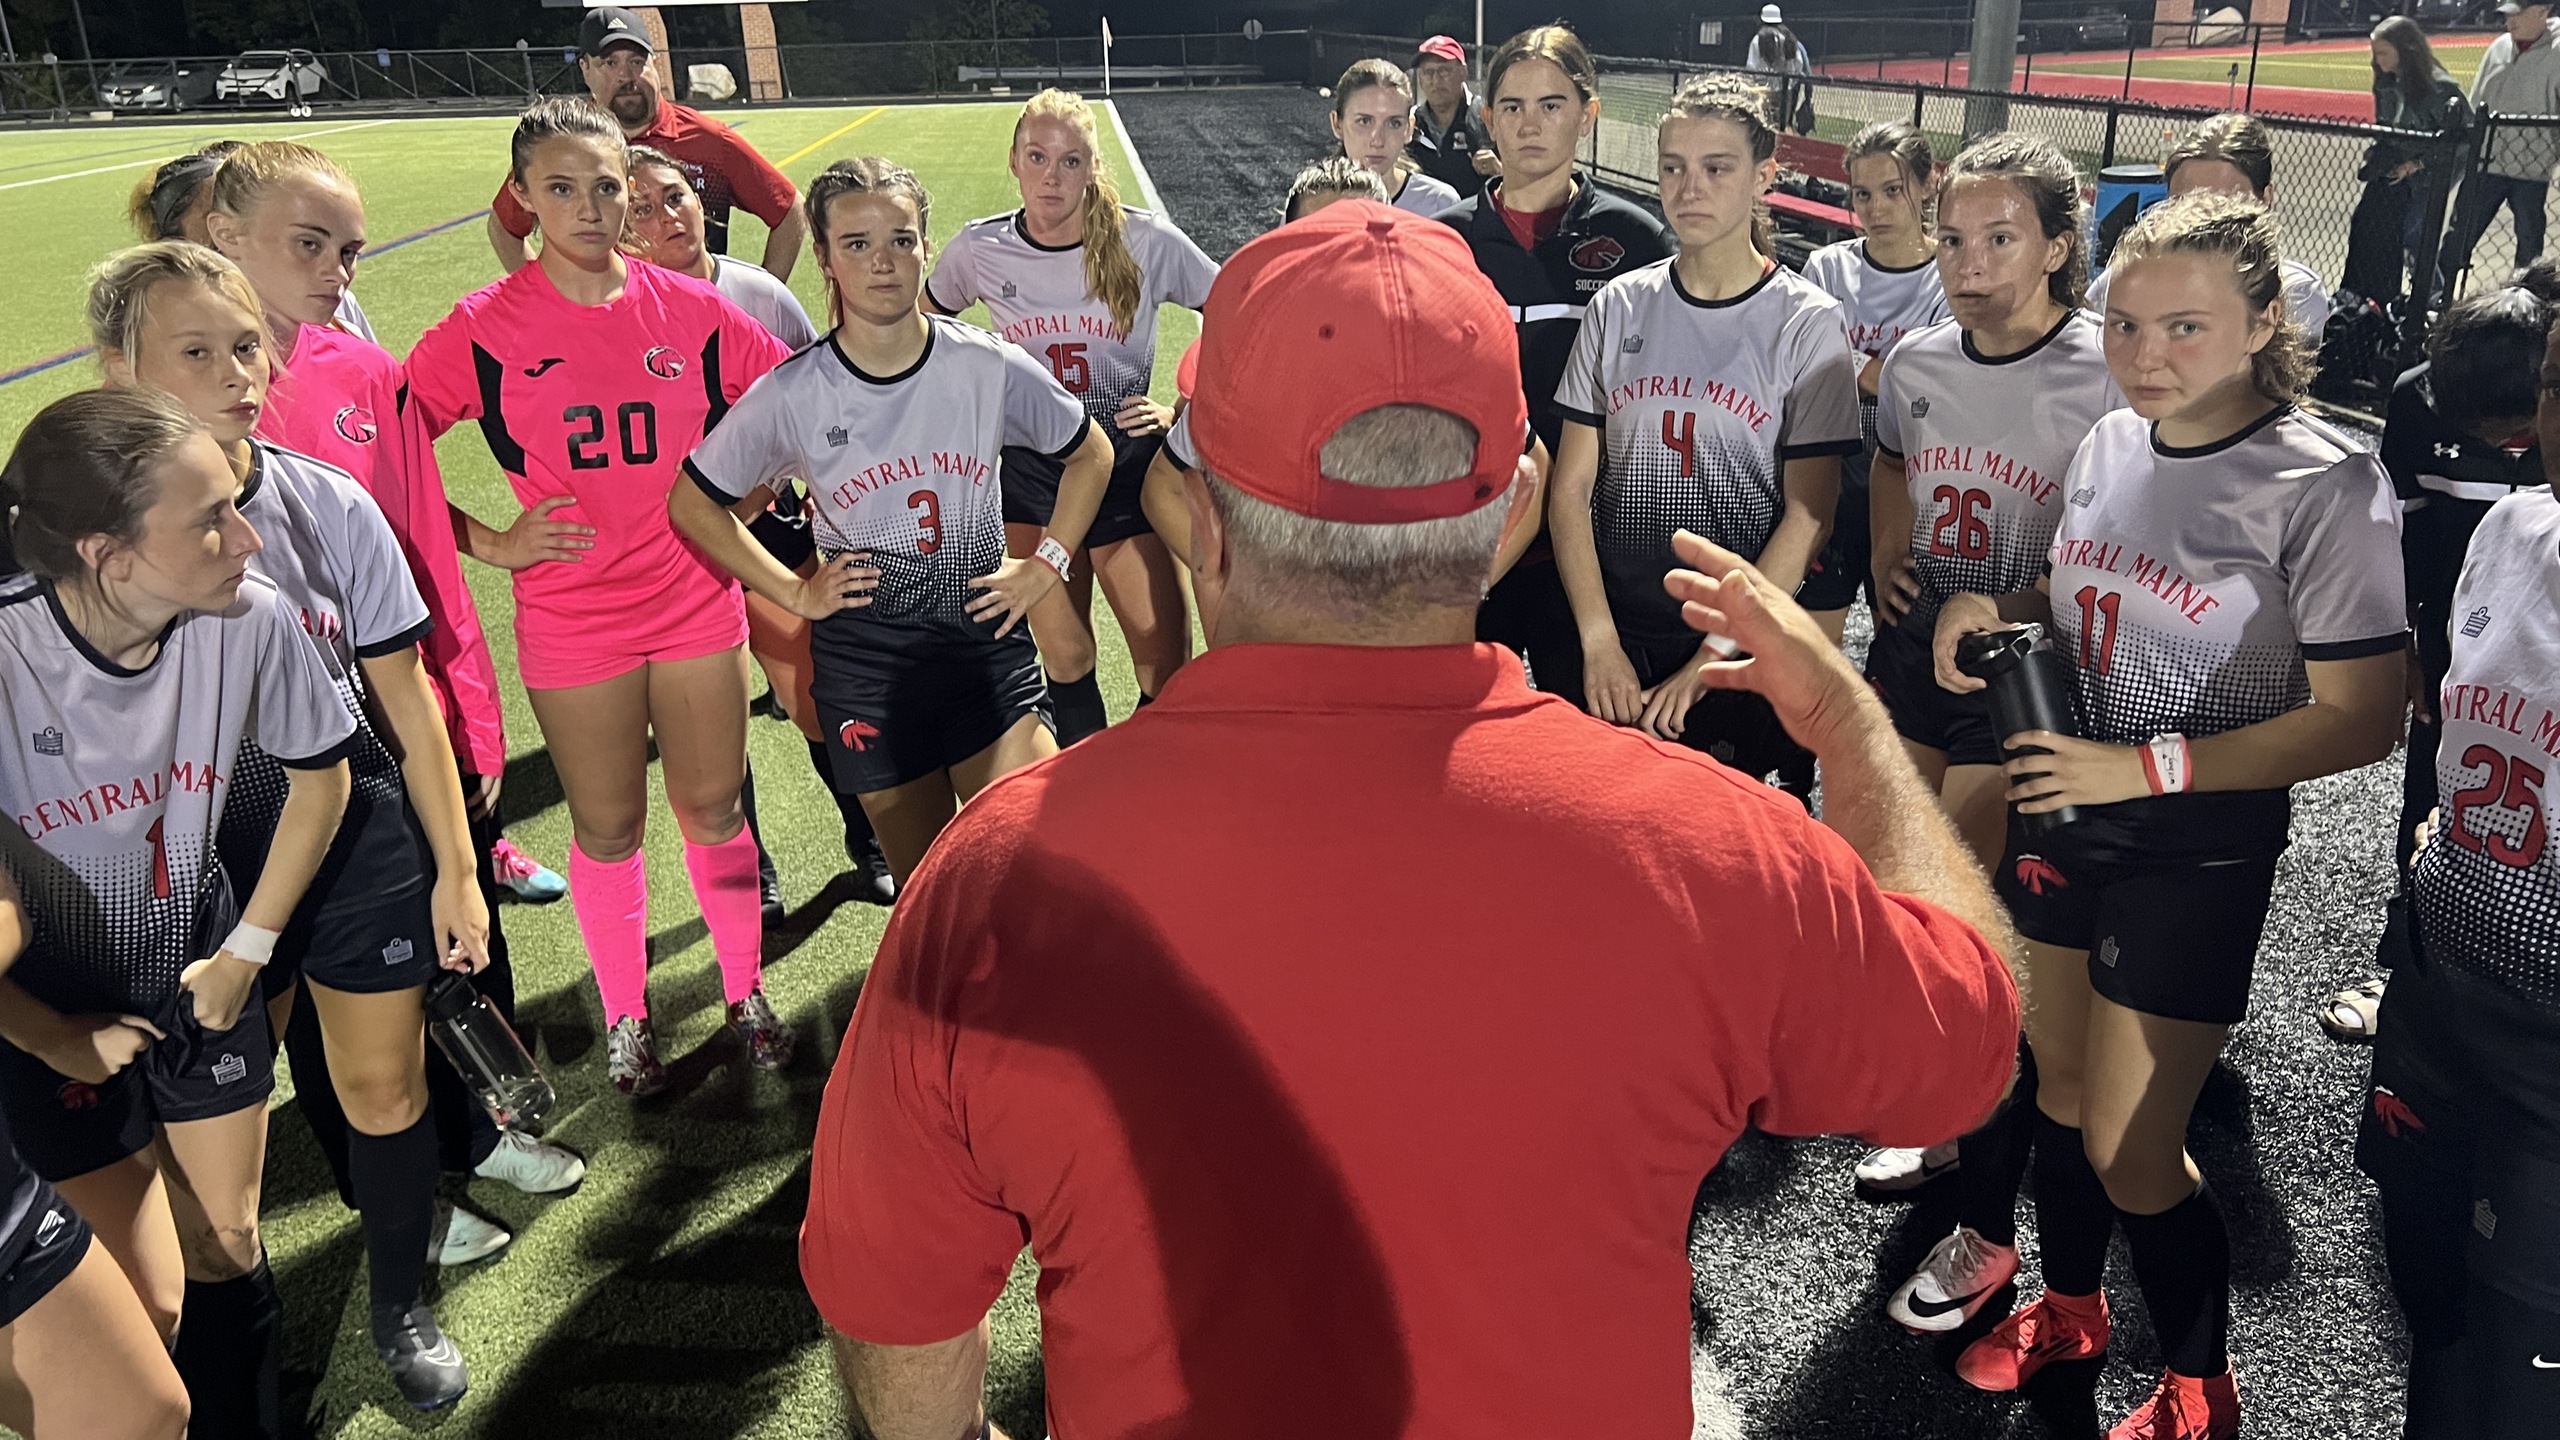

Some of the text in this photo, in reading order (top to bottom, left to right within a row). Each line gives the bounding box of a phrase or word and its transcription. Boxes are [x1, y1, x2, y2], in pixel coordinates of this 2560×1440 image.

[1575, 279, 1608, 291] SOCCE
[1001, 314, 1071, 344] ENTRAL
[1045, 343, 1090, 393] 15
[563, 401, 659, 470] 20
[1700, 380, 1772, 433] MAINE
[1662, 410, 1696, 478] 4
[1905, 446, 2060, 507] ENTRAL MAINE
[832, 455, 926, 510] CENTRAL
[907, 490, 943, 554] 3
[1930, 484, 1991, 561] 26
[2052, 540, 2220, 626] NTRAL MAINE
[2074, 585, 2121, 676] 11
[2444, 684, 2527, 735] NTRAL
[19, 773, 165, 840] CENTRAL
[2450, 744, 2546, 868] 25
[145, 815, 172, 899] 1
